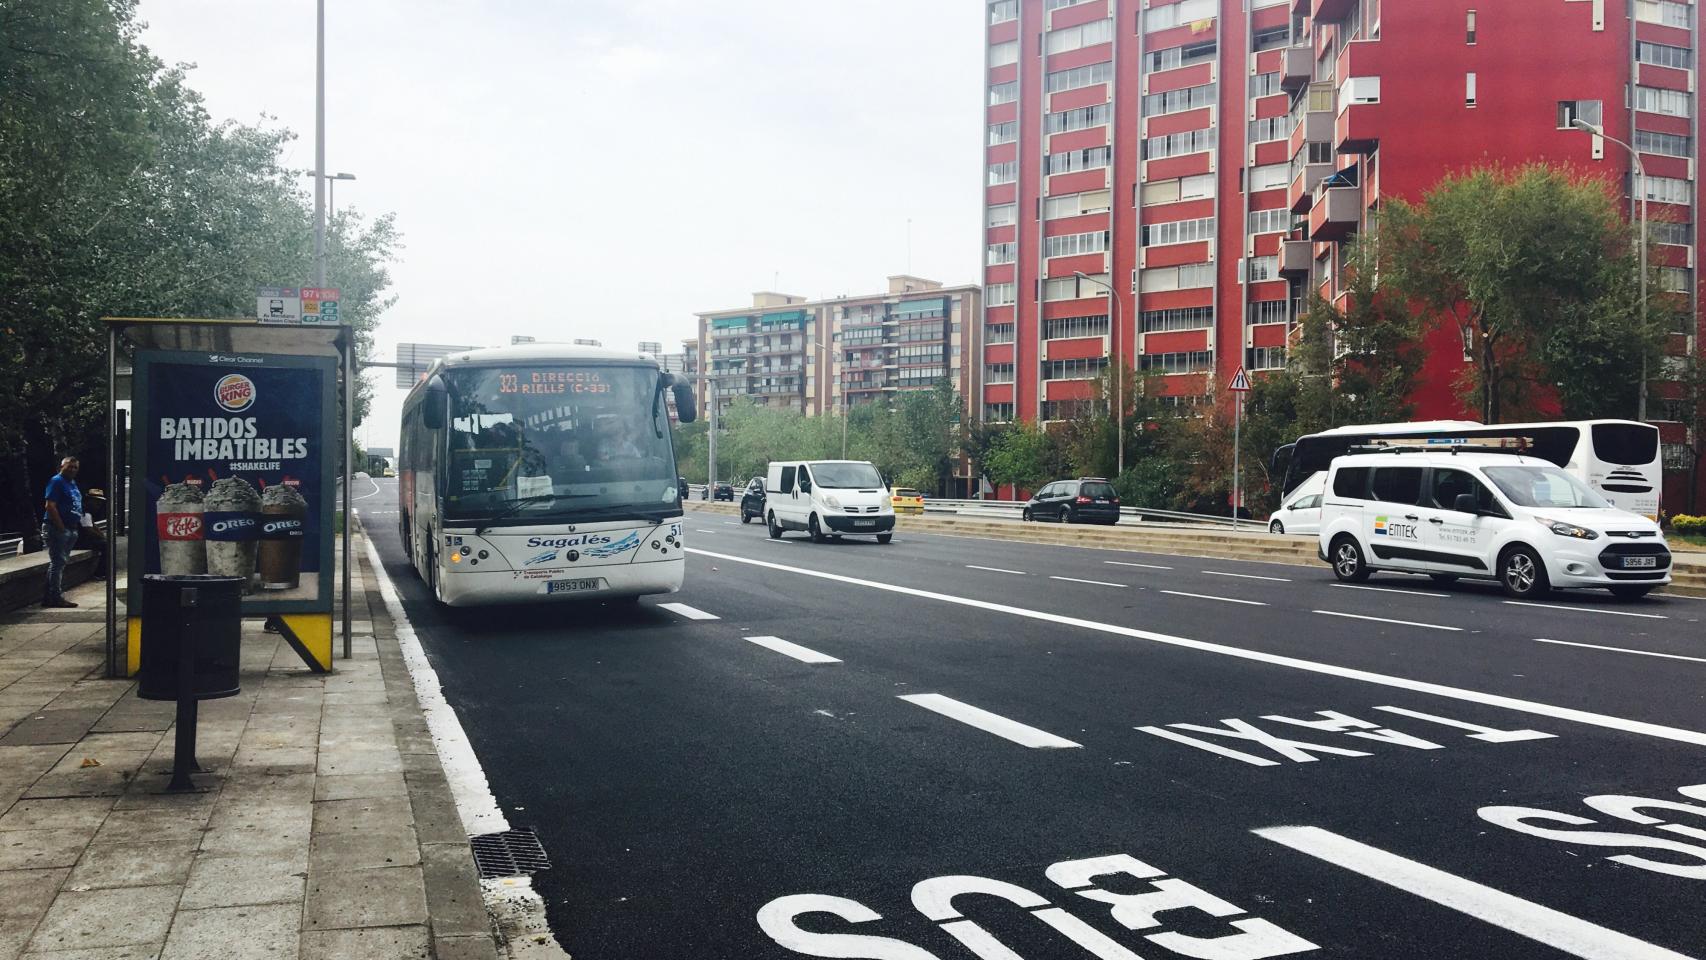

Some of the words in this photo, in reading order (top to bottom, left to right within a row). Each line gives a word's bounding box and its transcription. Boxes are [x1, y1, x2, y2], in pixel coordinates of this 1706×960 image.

[219, 381, 251, 394] BURGER
[500, 374, 517, 393] 323
[522, 383, 565, 394] RIELLS
[221, 388, 251, 404] KING
[160, 417, 257, 439] BATIDOS
[174, 437, 308, 461] IMBATIBLES
[229, 462, 281, 471] #SHAKELIFE
[212, 519, 255, 532] OREO
[263, 520, 301, 533] OREO
[1389, 523, 1418, 539] EMTEK
[526, 534, 611, 549] Sagalés
[554, 581, 576, 591] 9853
